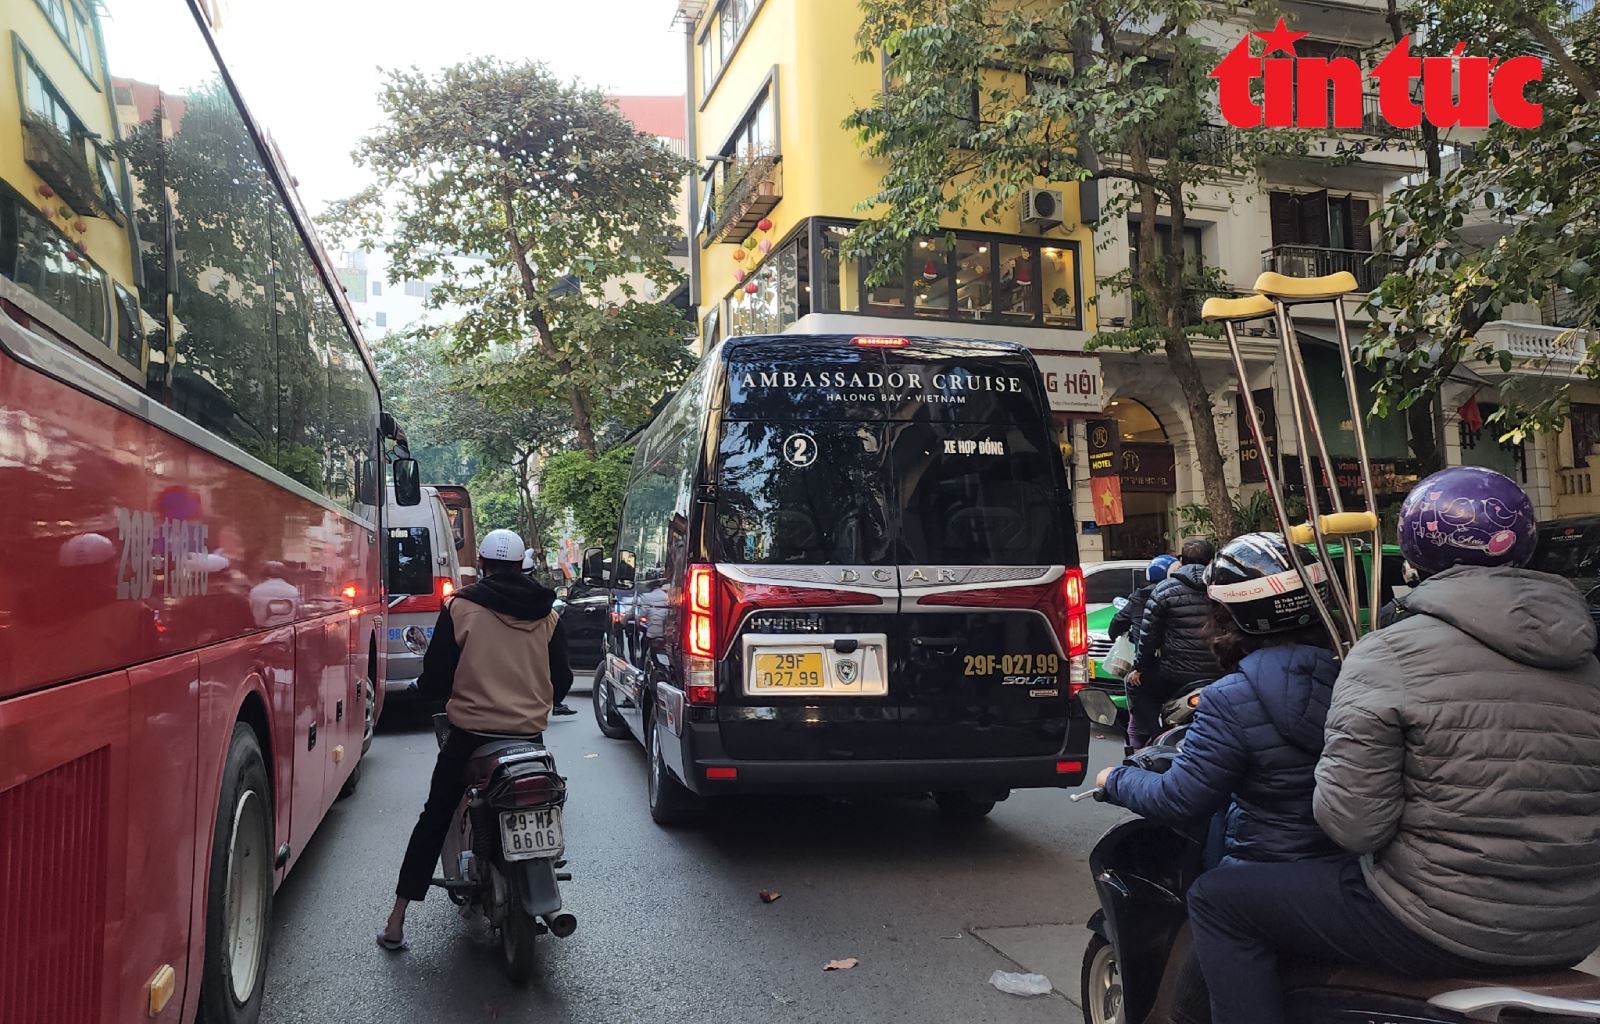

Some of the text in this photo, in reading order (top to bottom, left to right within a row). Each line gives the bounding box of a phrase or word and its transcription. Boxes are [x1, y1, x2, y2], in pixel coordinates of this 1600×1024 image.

[741, 372, 1022, 392] AMBASSADOR CRUISE
[1063, 369, 1097, 399] HỘI
[826, 393, 966, 404] HALONG BAY VIETNAM
[794, 438, 806, 462] 2
[944, 437, 1004, 457] XE HỢP ĐỒNG
[1092, 460, 1113, 470] HOTEL
[840, 568, 957, 583] DCAR
[751, 617, 824, 630] HYUNDAI
[775, 655, 805, 669] 29F
[964, 653, 1059, 675] 29F-027.99
[764, 671, 818, 686] 027.99
[1001, 675, 1058, 685] SOLATI
[513, 830, 556, 850] 8606
